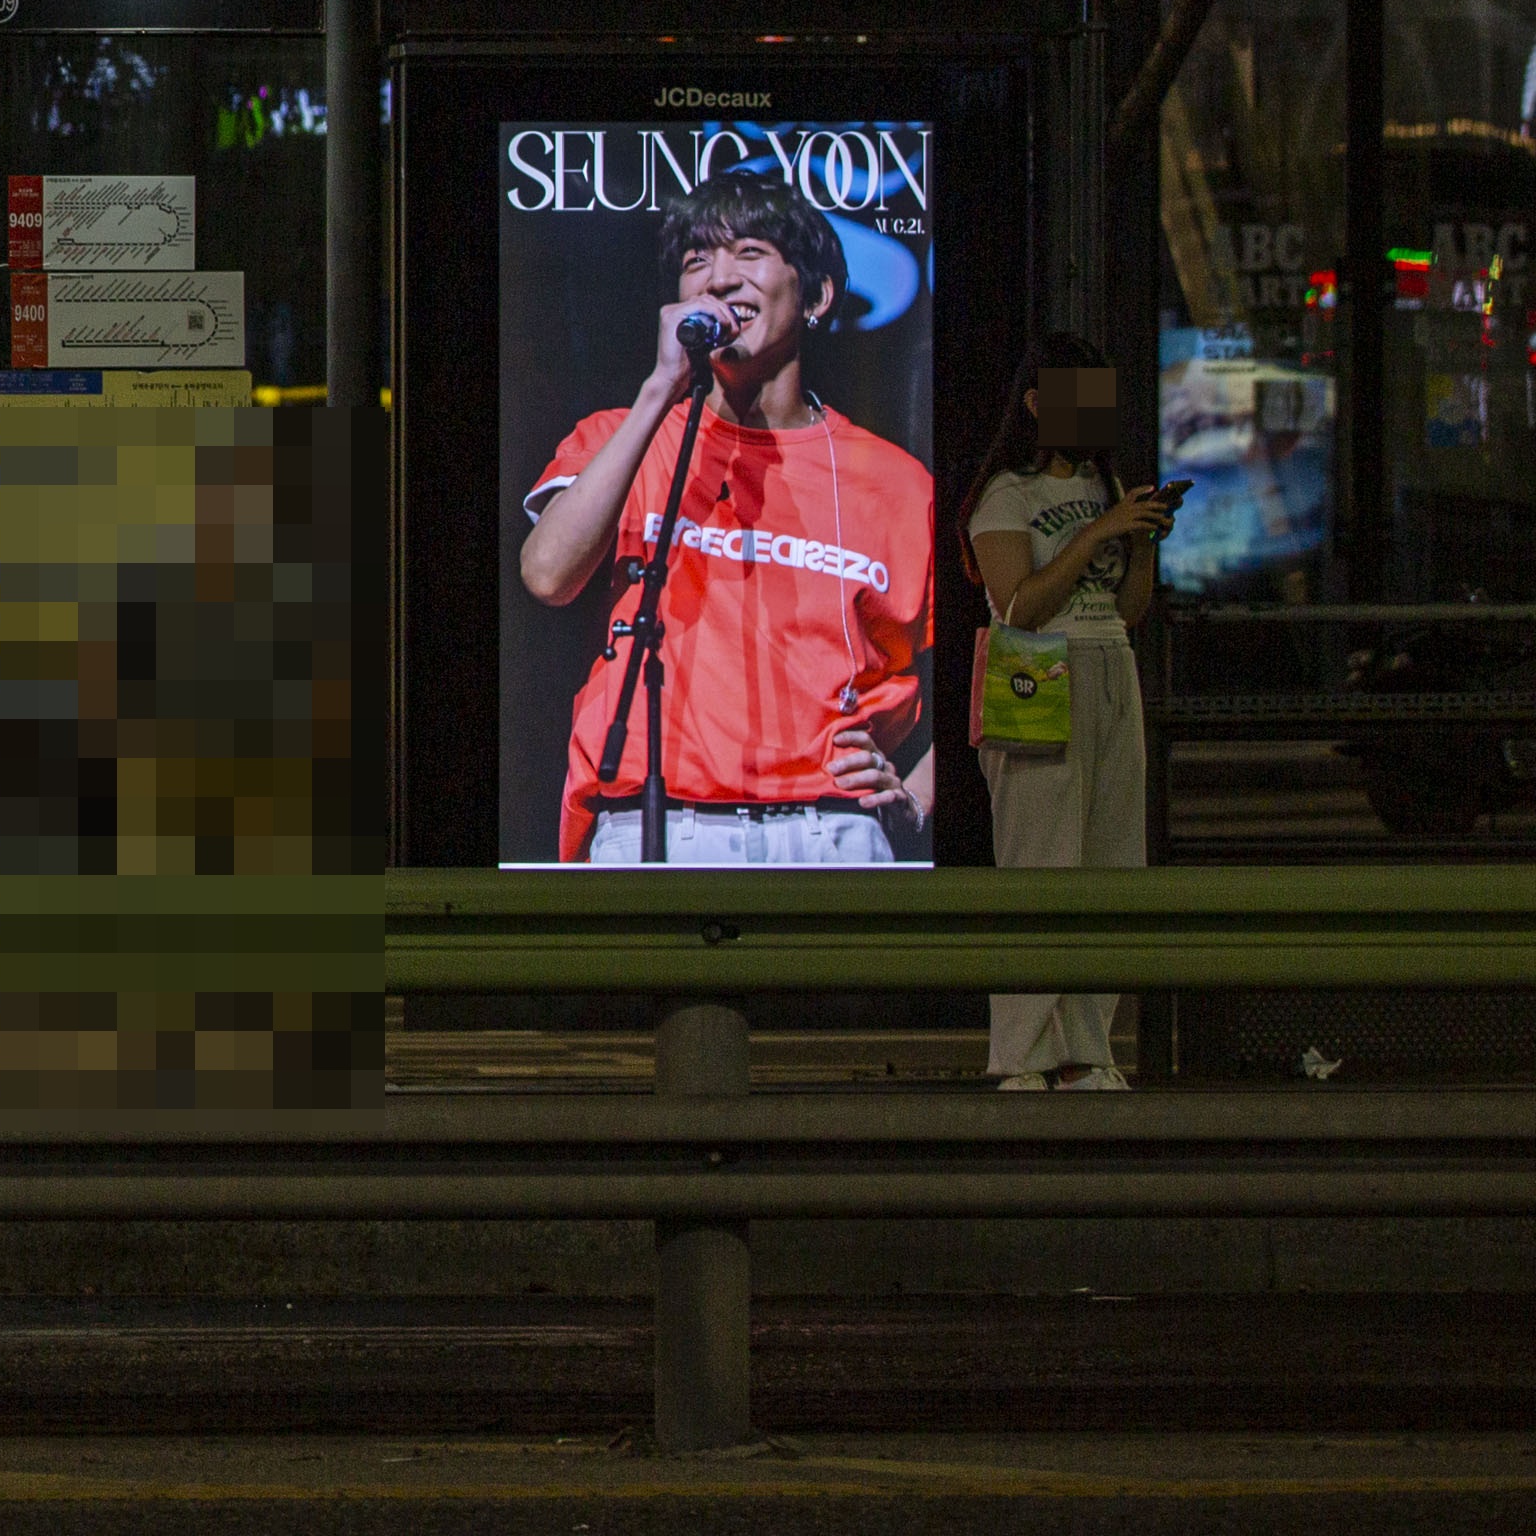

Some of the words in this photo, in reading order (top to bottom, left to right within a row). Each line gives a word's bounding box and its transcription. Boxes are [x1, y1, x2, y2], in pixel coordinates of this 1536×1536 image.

[654, 88, 772, 108] JCDecaux
[9, 212, 42, 228] 9409
[15, 305, 45, 322] 9400
[1012, 678, 1035, 695] BR
